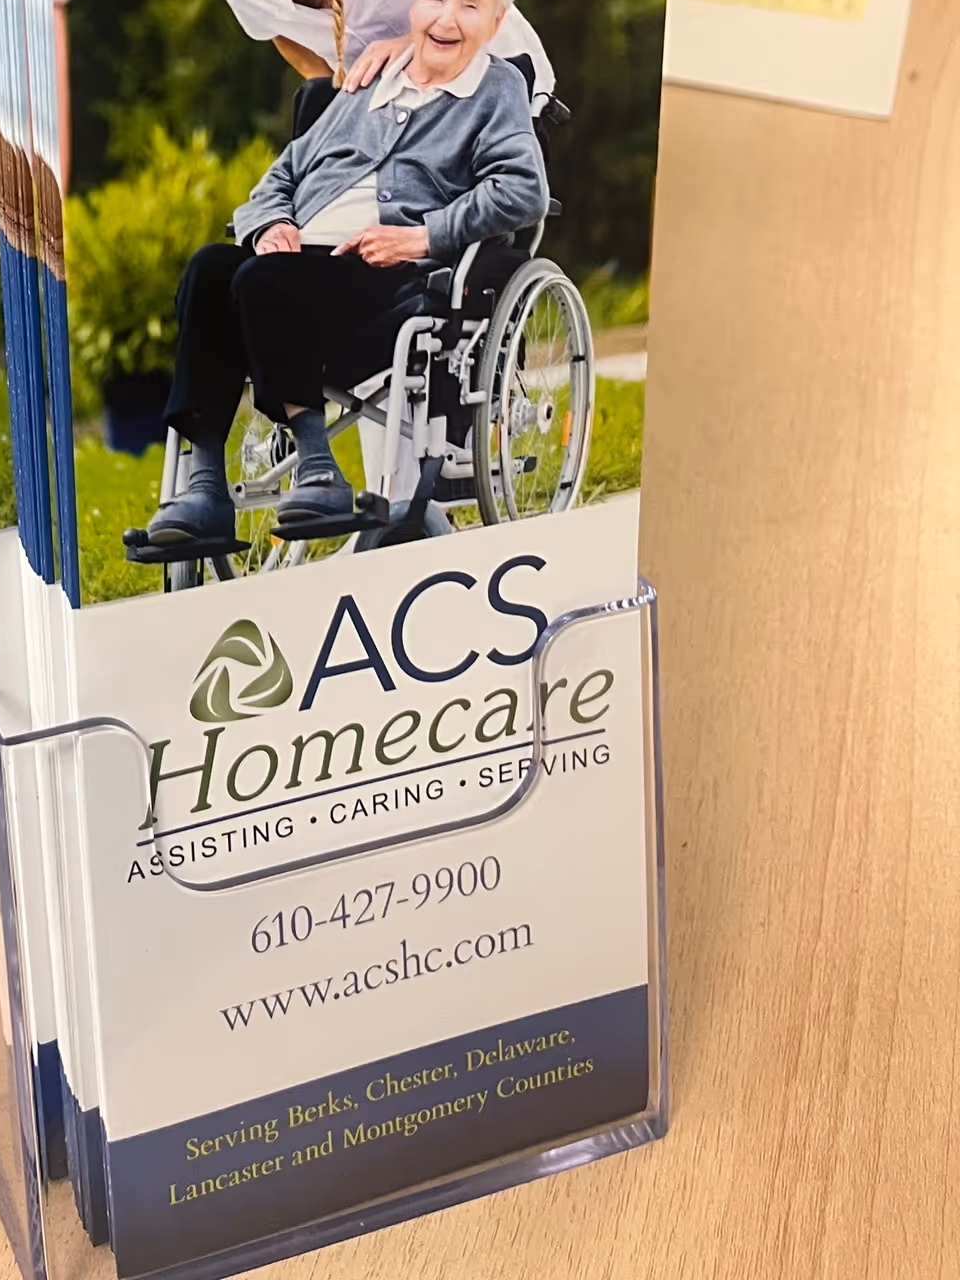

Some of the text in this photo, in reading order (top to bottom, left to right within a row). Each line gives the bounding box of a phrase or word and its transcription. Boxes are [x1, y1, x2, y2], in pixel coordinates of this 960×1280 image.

[298, 554, 548, 712] ACS
[127, 744, 611, 884] ASSISTING CARING SERVING
[138, 669, 615, 831] Homecare
[250, 856, 502, 954] 610-427-9900
[219, 922, 535, 1031] www.acshc.com
[168, 1057, 595, 1206] Lancaster and Montgomery Counties
[185, 1029, 576, 1161] Serving Berks, Chester, Delaware,
